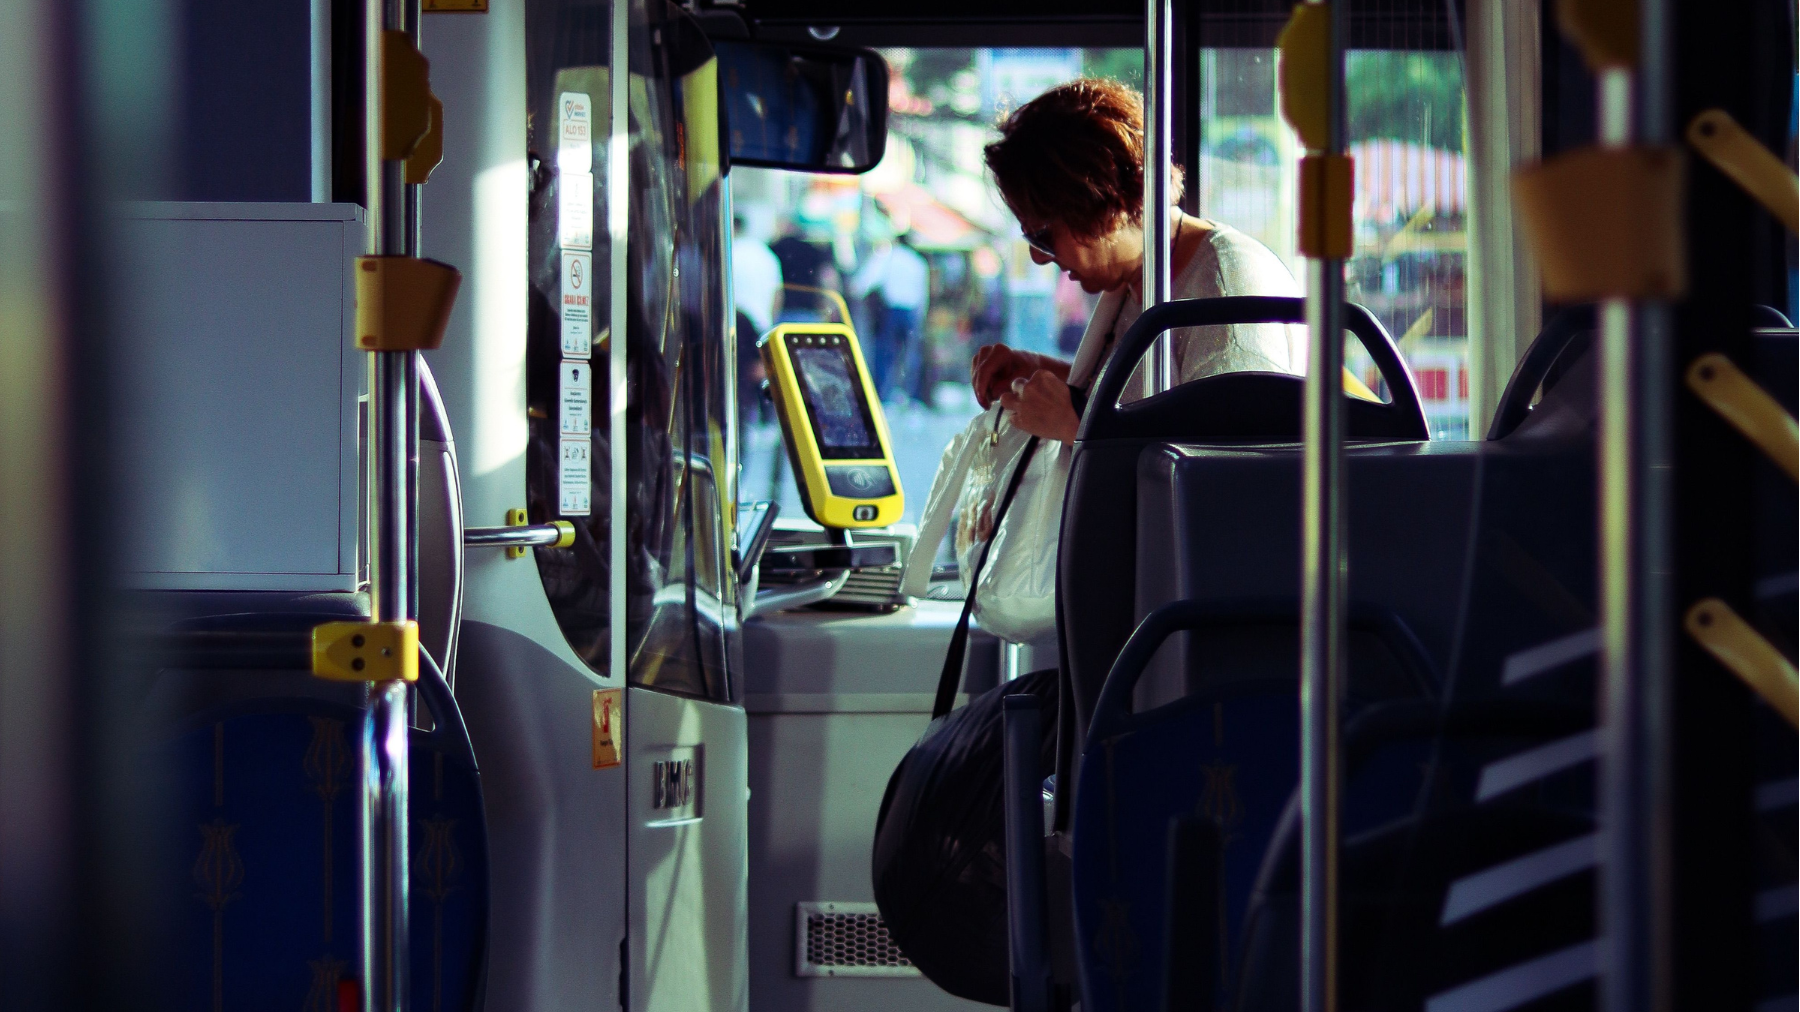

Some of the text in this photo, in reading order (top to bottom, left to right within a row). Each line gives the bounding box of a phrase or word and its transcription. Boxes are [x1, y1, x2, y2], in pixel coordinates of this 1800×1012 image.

[565, 125, 586, 136] ALO 153
[653, 759, 692, 809] BMC
